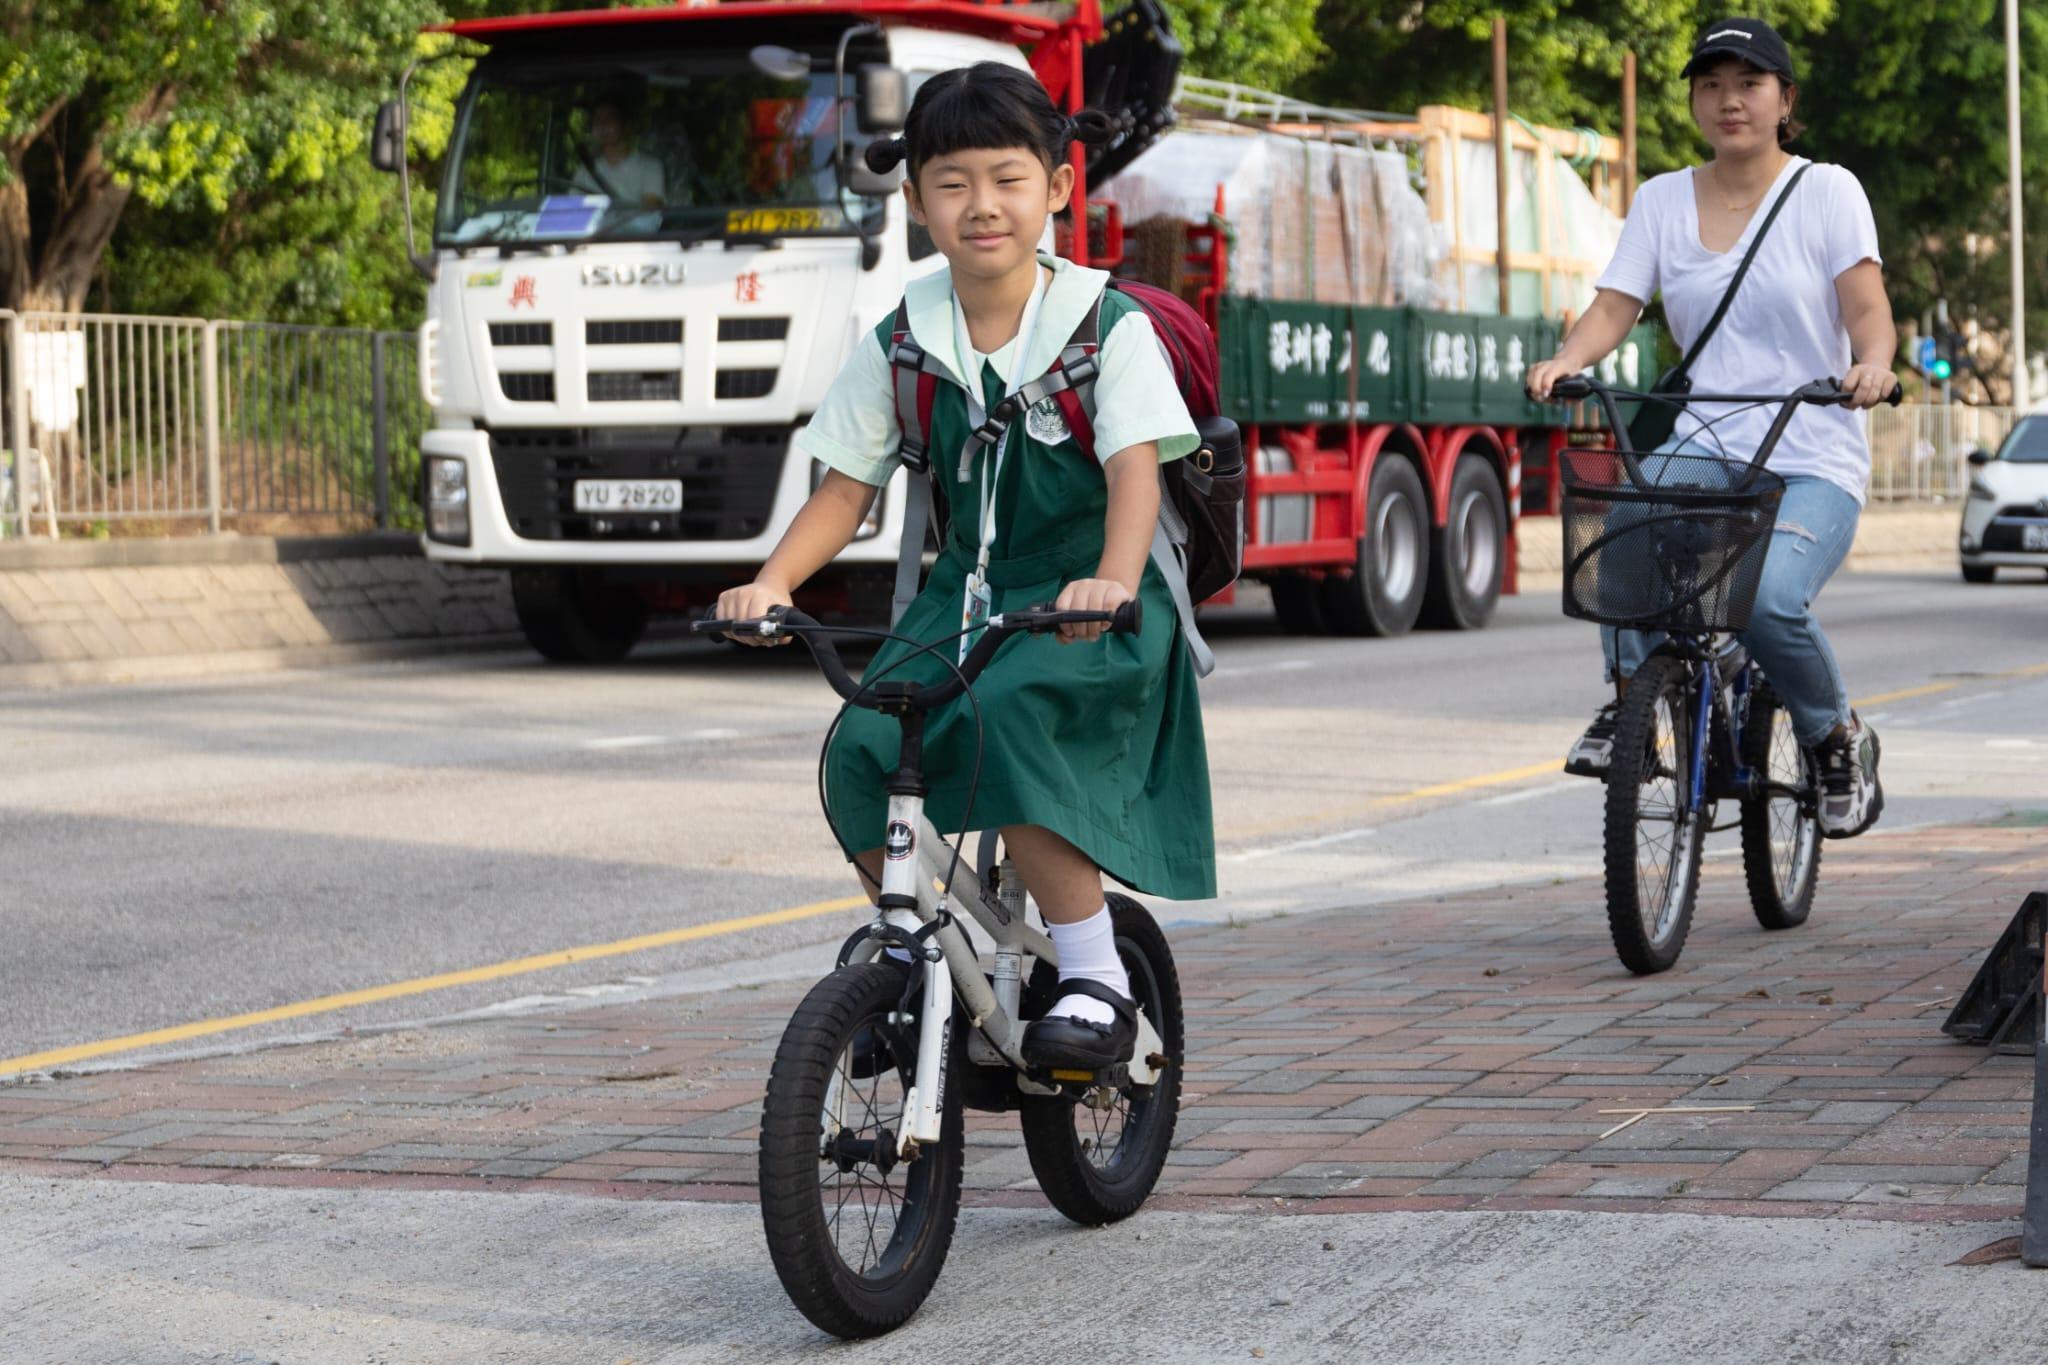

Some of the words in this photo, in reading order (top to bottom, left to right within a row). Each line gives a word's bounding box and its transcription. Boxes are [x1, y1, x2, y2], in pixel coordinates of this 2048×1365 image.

[581, 264, 684, 287] ISUZU
[585, 487, 609, 505] YU
[620, 486, 675, 505] 2820
